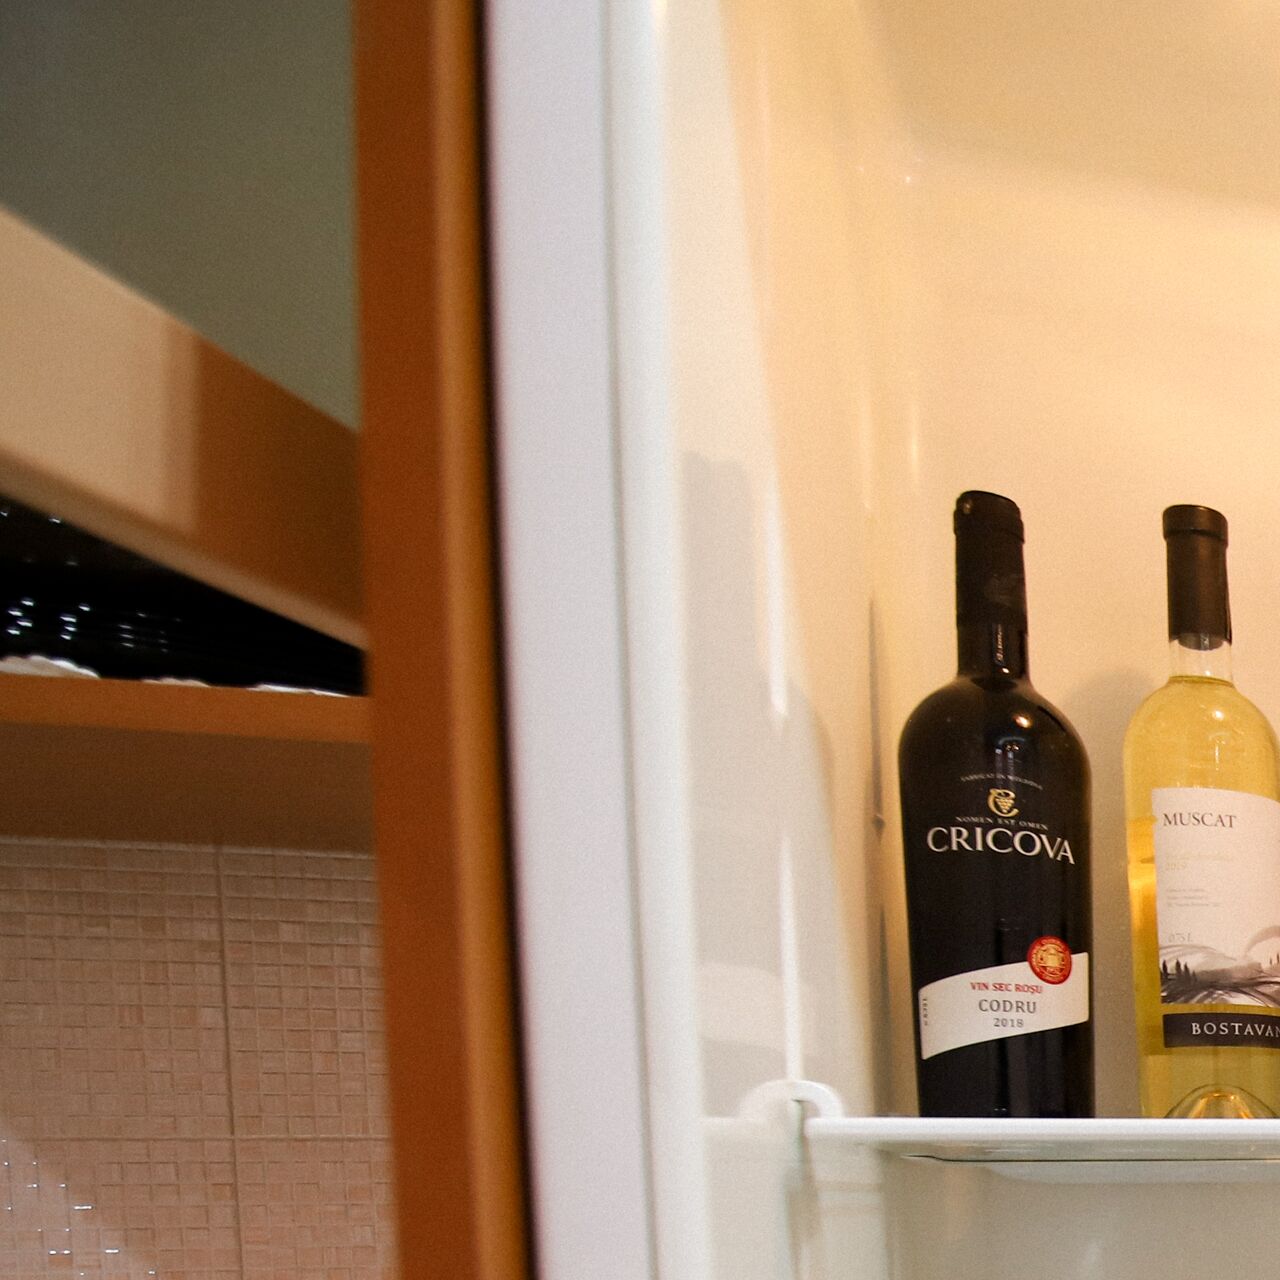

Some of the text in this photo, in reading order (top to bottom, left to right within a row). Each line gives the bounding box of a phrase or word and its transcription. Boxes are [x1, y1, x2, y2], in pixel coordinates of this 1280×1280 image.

[1162, 812, 1238, 829] MUSCAT
[926, 826, 1076, 865] CRICOVA
[970, 981, 989, 991] VIN
[992, 982, 1013, 992] SEC
[977, 999, 1038, 1015] CODRU
[993, 1017, 1025, 1028] 2018
